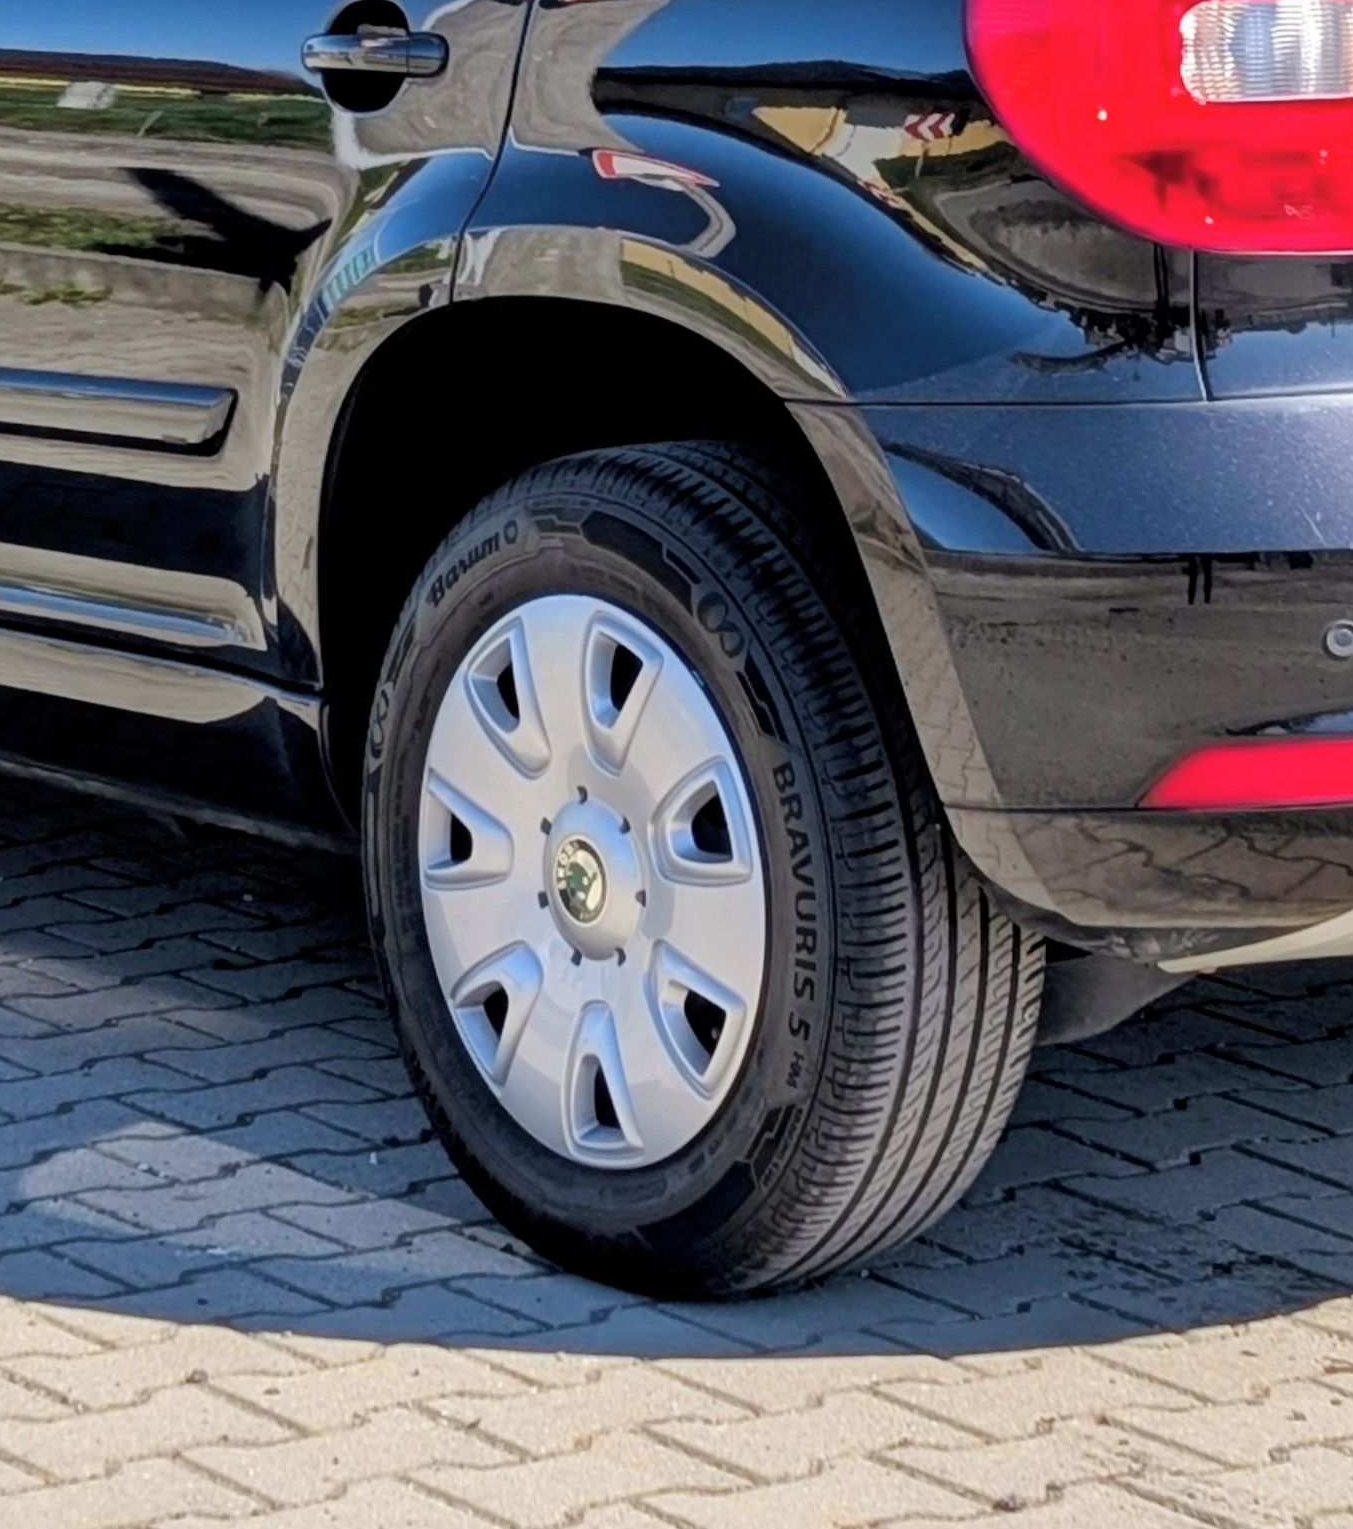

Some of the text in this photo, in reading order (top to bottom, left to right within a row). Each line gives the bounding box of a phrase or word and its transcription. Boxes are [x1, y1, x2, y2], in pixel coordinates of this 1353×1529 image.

[425, 533, 500, 609] Barum
[772, 761, 817, 1001] BRAVURIS
[788, 1011, 811, 1043] 5
